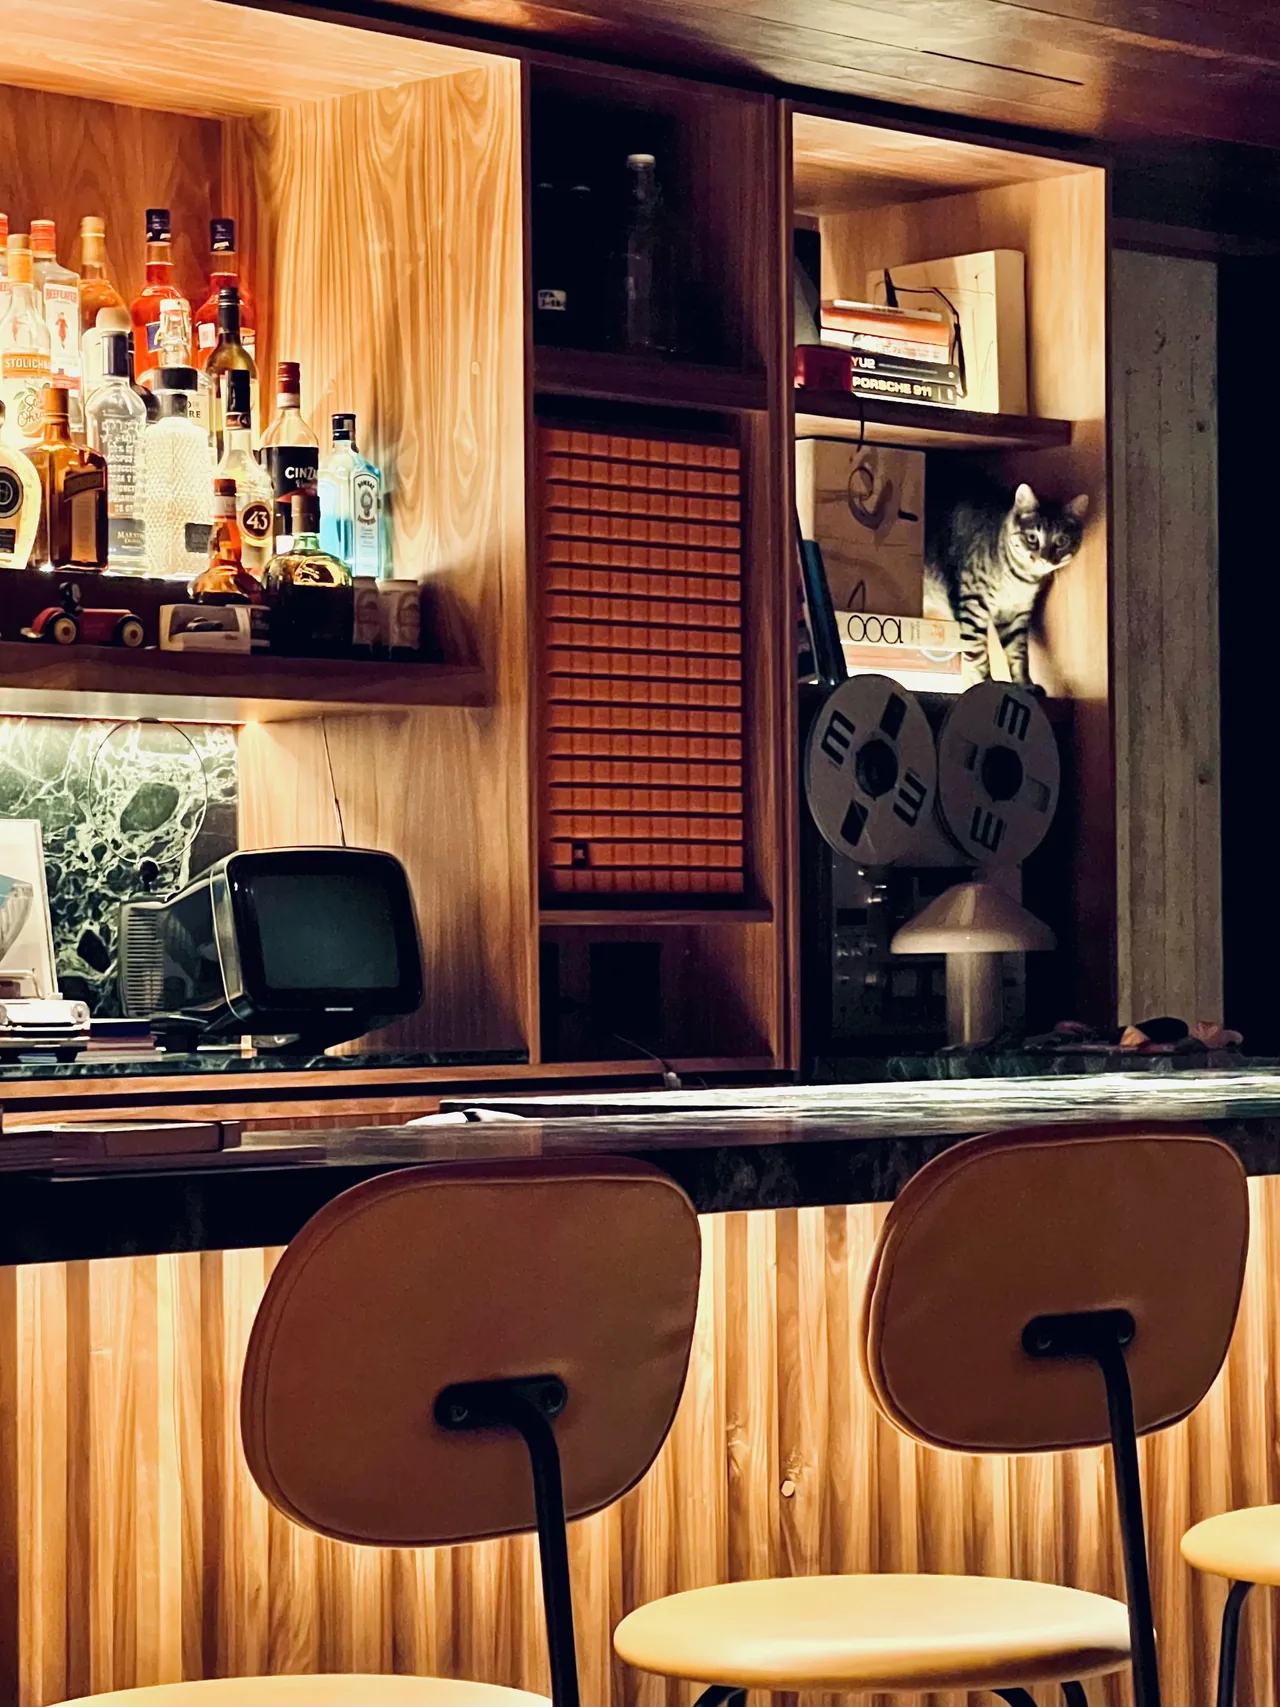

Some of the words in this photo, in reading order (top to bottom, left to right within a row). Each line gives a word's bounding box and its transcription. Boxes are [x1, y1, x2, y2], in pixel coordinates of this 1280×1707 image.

[852, 376, 911, 394] PORSCHE
[913, 385, 932, 398] 911
[246, 510, 268, 530] 43
